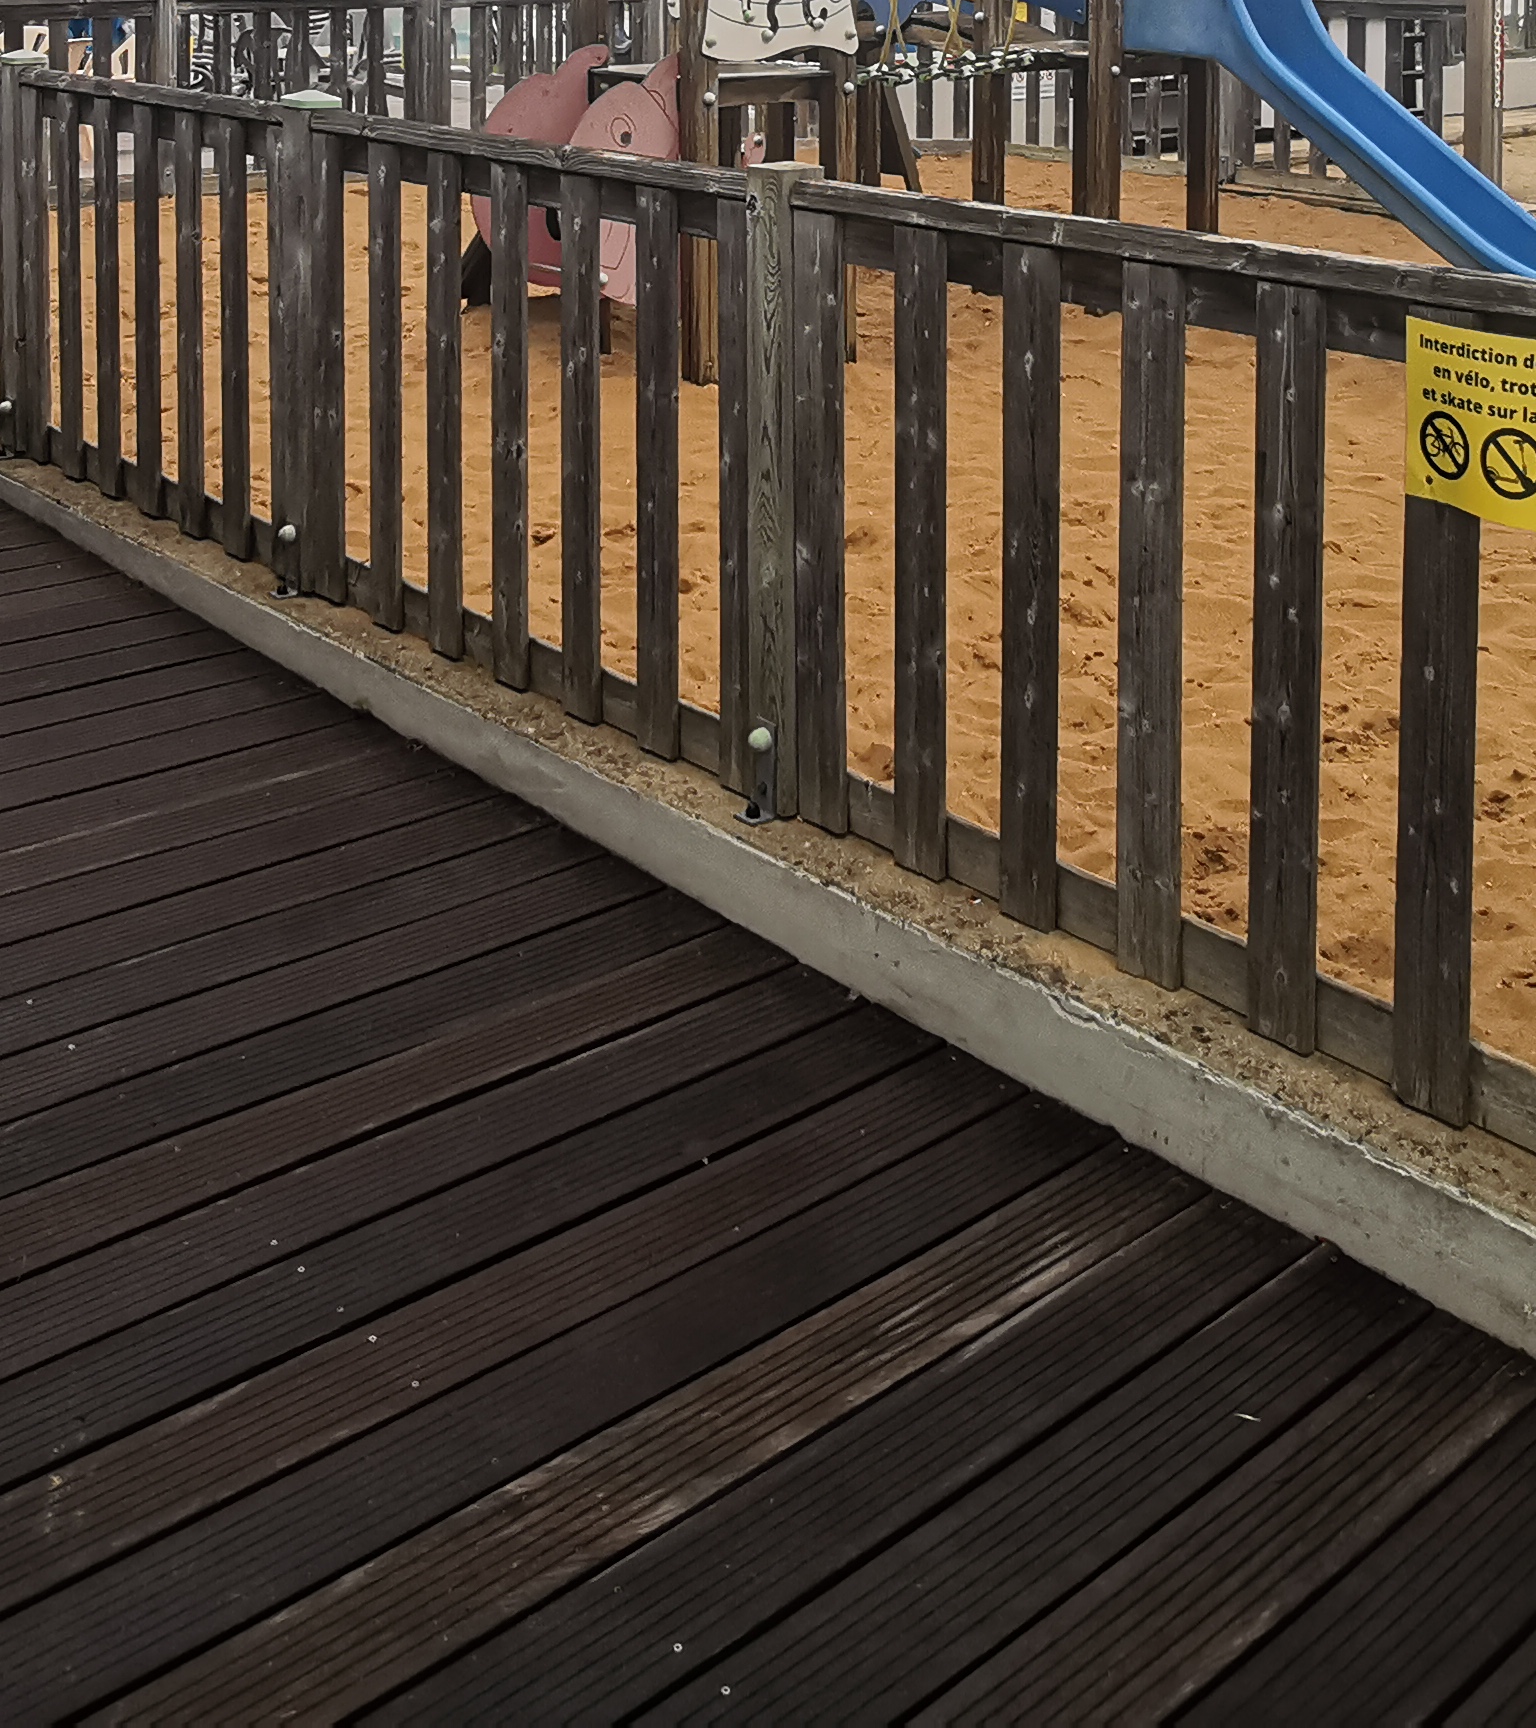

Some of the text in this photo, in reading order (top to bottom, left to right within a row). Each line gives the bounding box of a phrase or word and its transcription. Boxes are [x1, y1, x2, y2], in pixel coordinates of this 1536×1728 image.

[1419, 333, 1518, 368] Interdiction
[1433, 364, 1452, 381] en
[1455, 366, 1496, 392] vélo,
[1422, 386, 1437, 402] et
[1440, 390, 1483, 414] skate
[1487, 402, 1518, 421] sur
